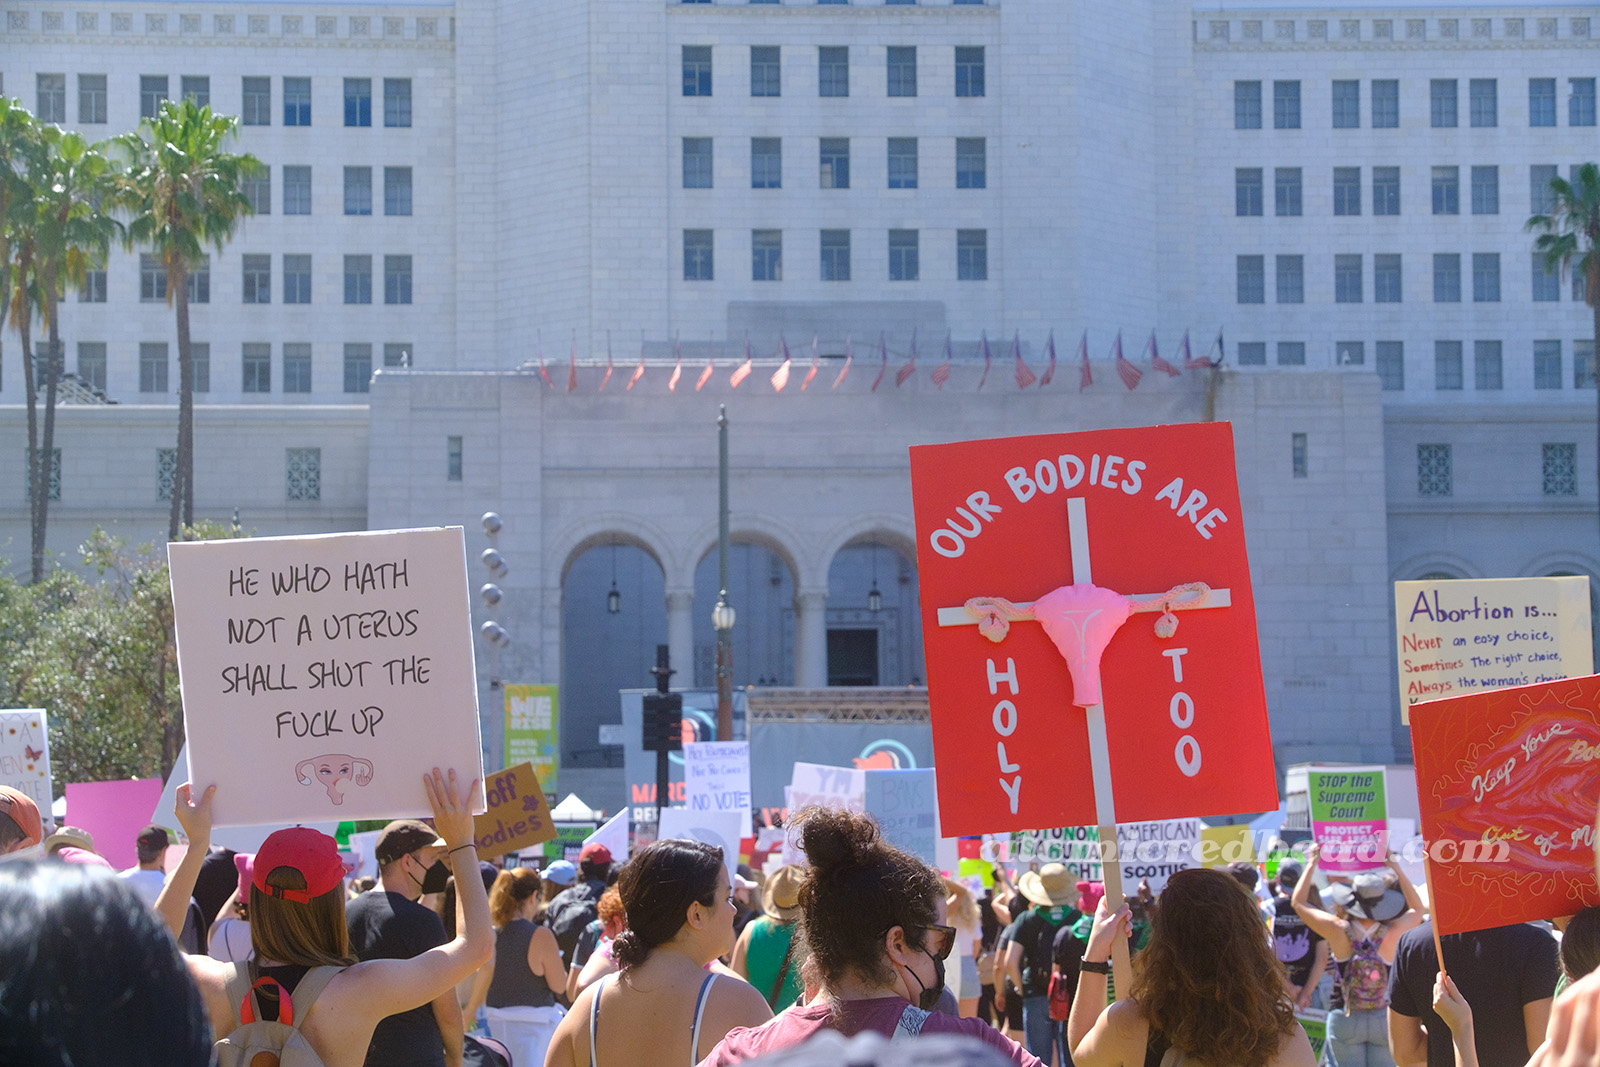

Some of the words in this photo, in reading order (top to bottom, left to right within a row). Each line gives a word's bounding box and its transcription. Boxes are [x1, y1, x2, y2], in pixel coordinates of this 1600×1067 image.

[930, 490, 1003, 558] OUR
[1003, 453, 1147, 503] BODIES
[1154, 477, 1228, 540] ARE
[229, 566, 259, 596] HE
[271, 563, 331, 596] WHO
[344, 559, 409, 594] HATH
[1409, 590, 1514, 622] Abortion
[228, 617, 285, 644] NOT
[296, 614, 312, 646] A
[323, 609, 419, 640] UTERUS
[1402, 633, 1443, 653] Never
[1452, 636, 1466, 646] an
[1473, 634, 1500, 646] easy
[1506, 629, 1554, 642] choice,
[1404, 658, 1464, 674] Sometimes
[1495, 653, 1523, 668] right
[1528, 651, 1563, 664] choice,
[221, 663, 298, 696] SHALL
[308, 659, 373, 689] SHUT
[382, 655, 431, 685] THE
[1407, 680, 1452, 697] Always
[1457, 677, 1478, 688] the
[1481, 672, 1529, 688] woman's
[275, 709, 343, 739] FUCK
[351, 706, 384, 737] UP
[1162, 647, 1202, 778] TOO
[986, 656, 1022, 815] HOLY
[0, 754, 23, 775] EN
[1318, 775, 1347, 788] STOP
[1350, 775, 1373, 787] the
[1471, 757, 1516, 803] Keep
[692, 793, 711, 810] NO
[714, 791, 750, 810] VOTE
[1318, 790, 1375, 804] Supreme
[1330, 806, 1365, 818] Court
[1117, 821, 1197, 841] AMERICAN
[1324, 825, 1373, 835] PROTECT
[1533, 831, 1568, 857] of
[1124, 863, 1189, 879] SCOTUS
